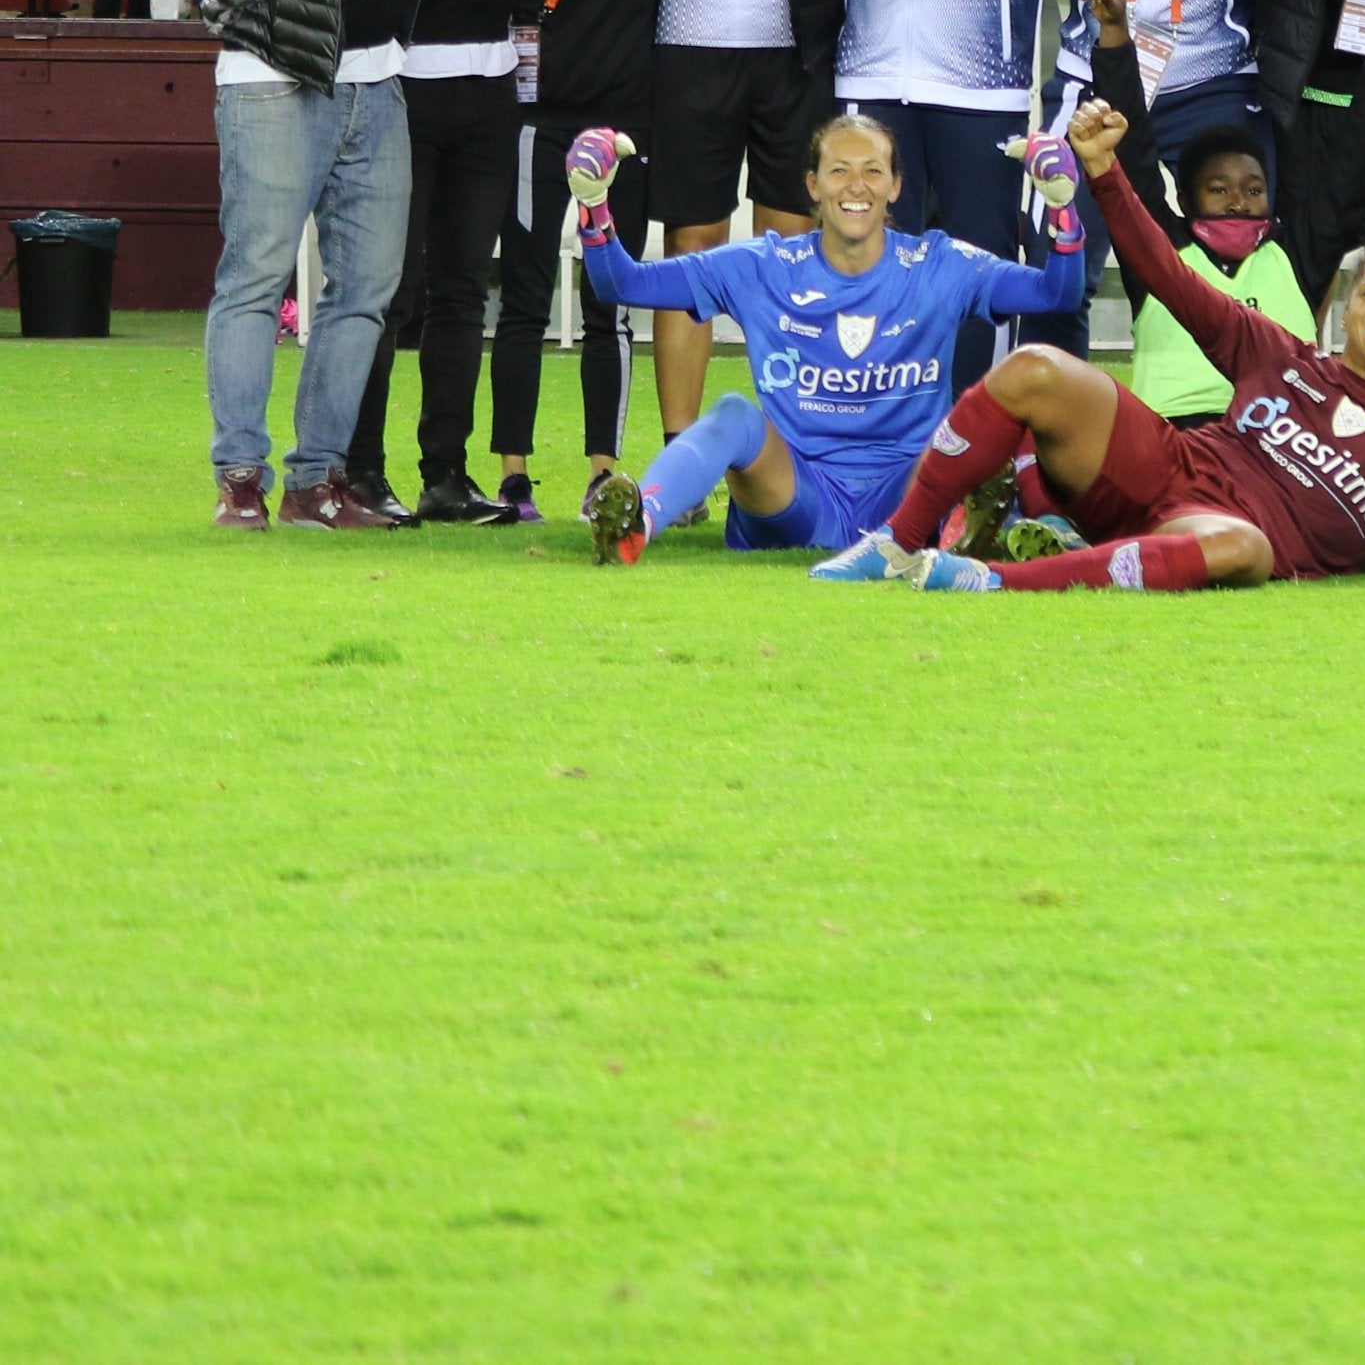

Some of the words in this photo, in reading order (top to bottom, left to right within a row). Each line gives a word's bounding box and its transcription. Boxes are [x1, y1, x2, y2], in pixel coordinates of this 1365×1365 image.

[798, 358, 940, 397] gesitma
[799, 401, 836, 414] FERALCO
[837, 404, 867, 414] GROUP
[1286, 463, 1314, 489] GROUP
